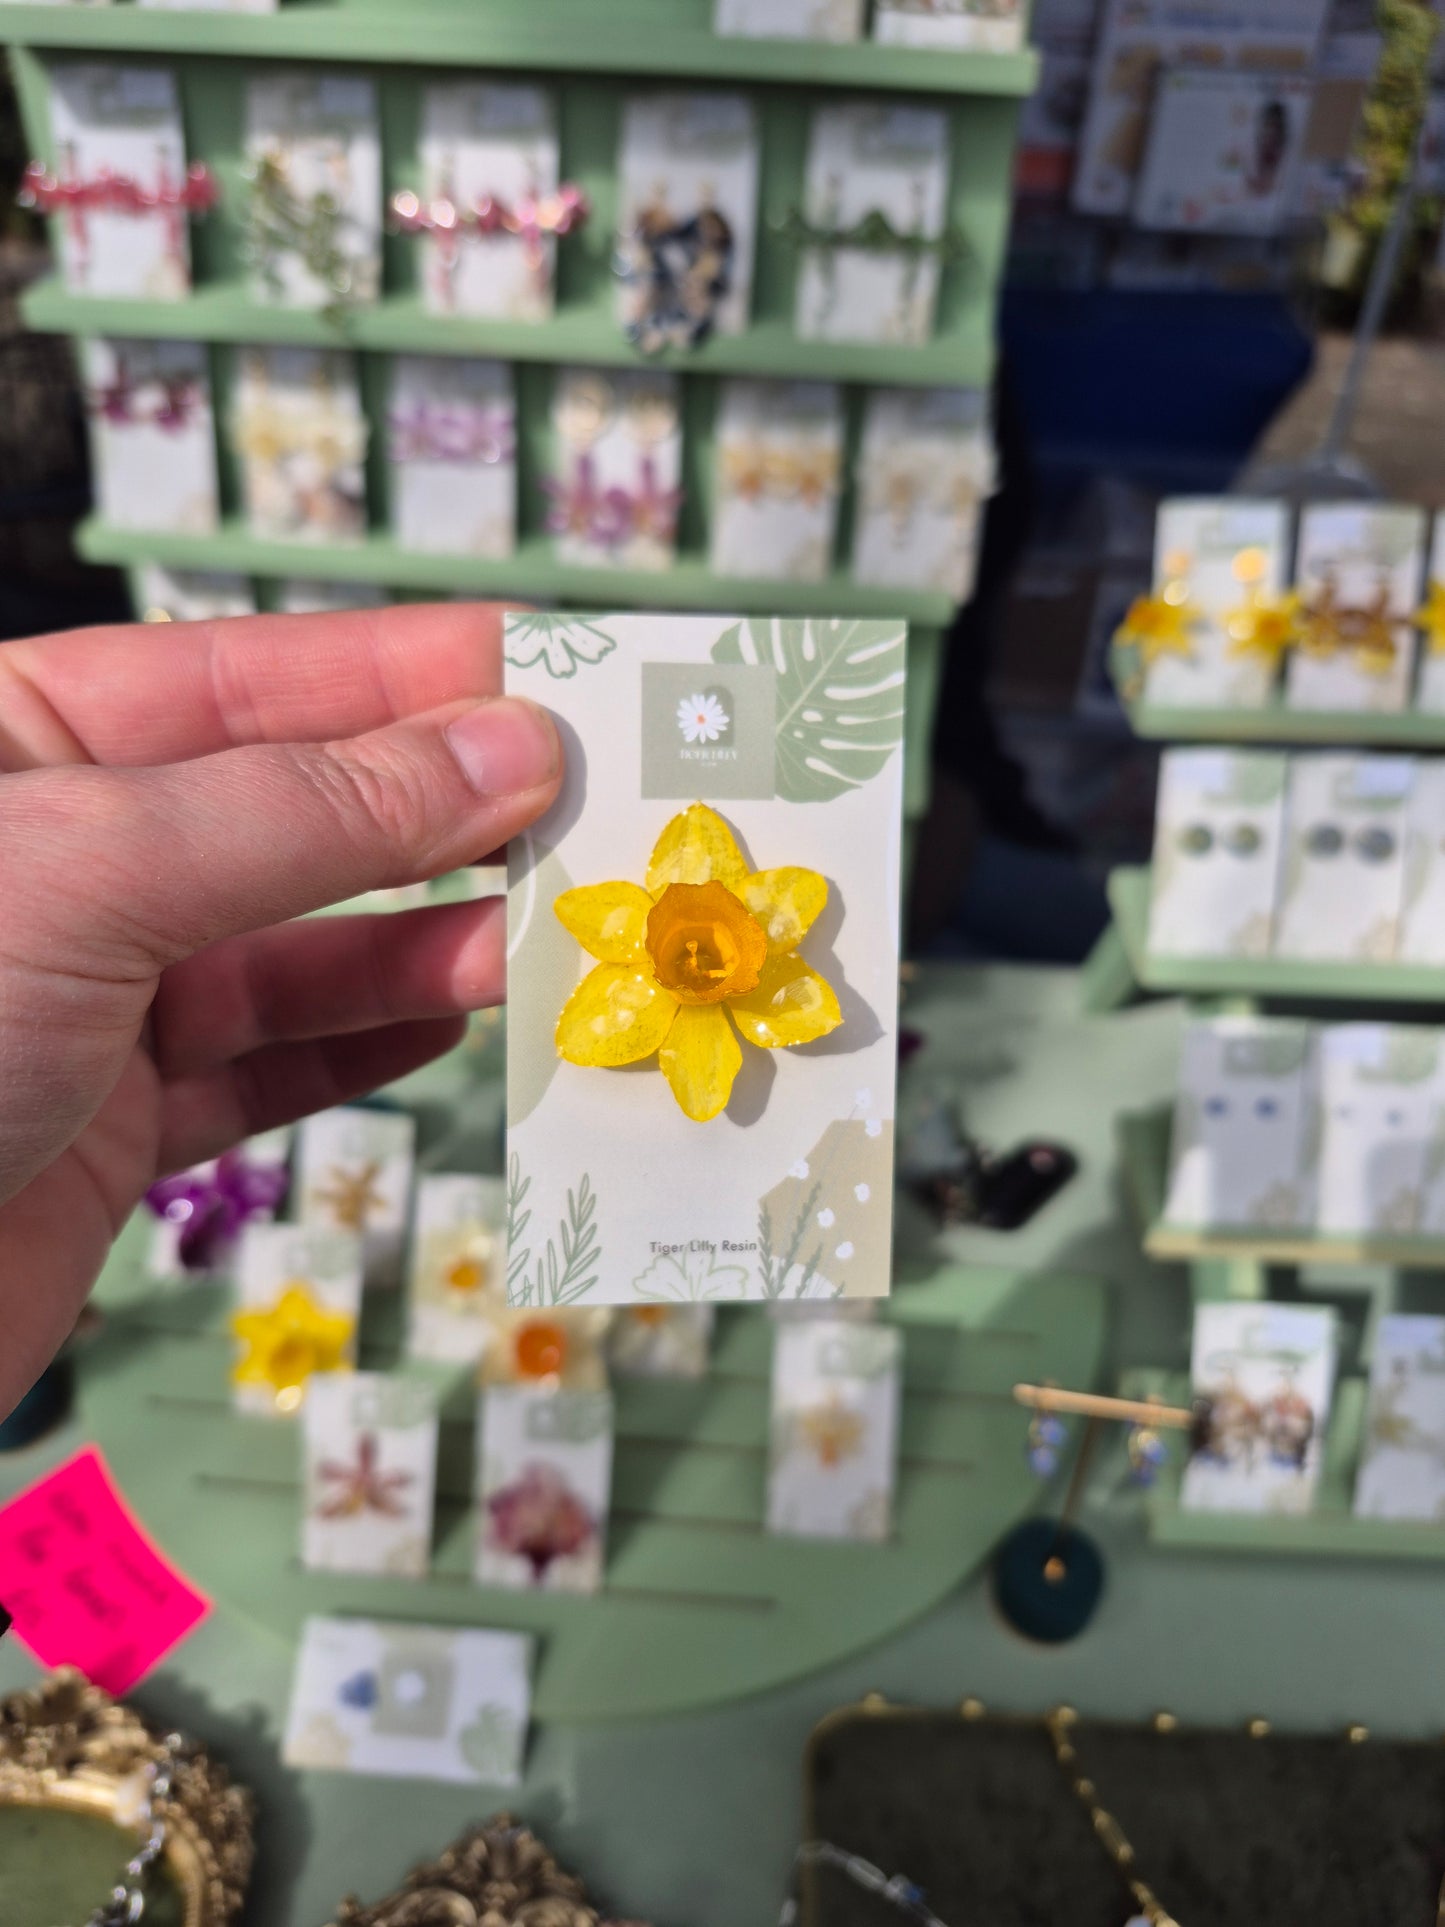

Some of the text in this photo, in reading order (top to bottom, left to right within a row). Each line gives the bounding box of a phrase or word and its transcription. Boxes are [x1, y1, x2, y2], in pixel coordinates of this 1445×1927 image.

[649, 1239, 757, 1255] Tiger Lilly Resin
